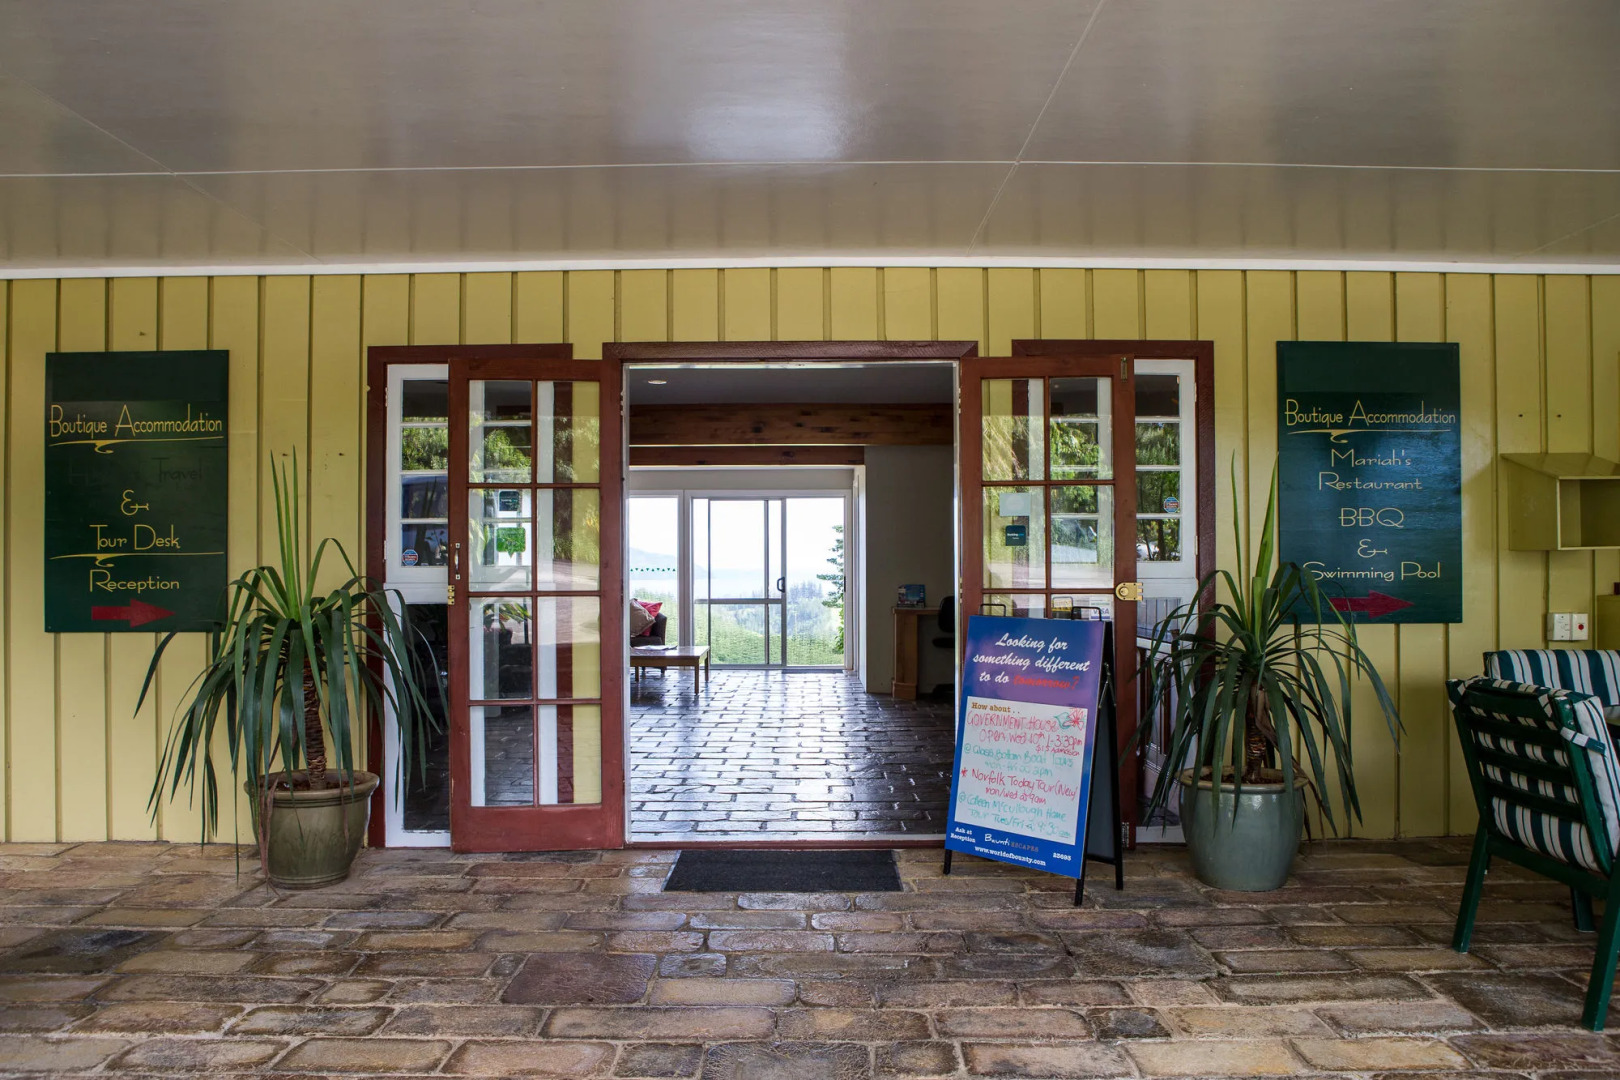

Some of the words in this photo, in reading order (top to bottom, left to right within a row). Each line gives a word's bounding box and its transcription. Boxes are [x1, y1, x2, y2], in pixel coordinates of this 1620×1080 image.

[49, 404, 107, 439] Boutique
[115, 403, 222, 437] Accommodation
[1285, 399, 1343, 428] Boutique
[1349, 400, 1455, 426] Accommodation
[1331, 448, 1412, 468] Mariah's
[1319, 471, 1423, 491] Restaurant
[121, 489, 149, 516] &
[1338, 507, 1404, 528] BBQ
[89, 524, 127, 550] Tour
[134, 524, 180, 550] Desk
[1357, 539, 1388, 558] &
[89, 569, 180, 593] Reception
[1303, 561, 1395, 582] Swimming
[1401, 561, 1441, 581] Pool
[995, 633, 1046, 653] Looking
[1048, 637, 1068, 653] for
[973, 653, 1030, 670] something
[1034, 655, 1090, 673] different
[979, 671, 991, 682] to
[995, 671, 1009, 683] do
[1013, 675, 1079, 690] tomorrow?
[971, 702, 988, 710] How
[972, 768, 1005, 786] Norfolk
[1007, 775, 1035, 790] Today
[1036, 779, 1055, 793] Tour
[950, 833, 976, 844] Reception
